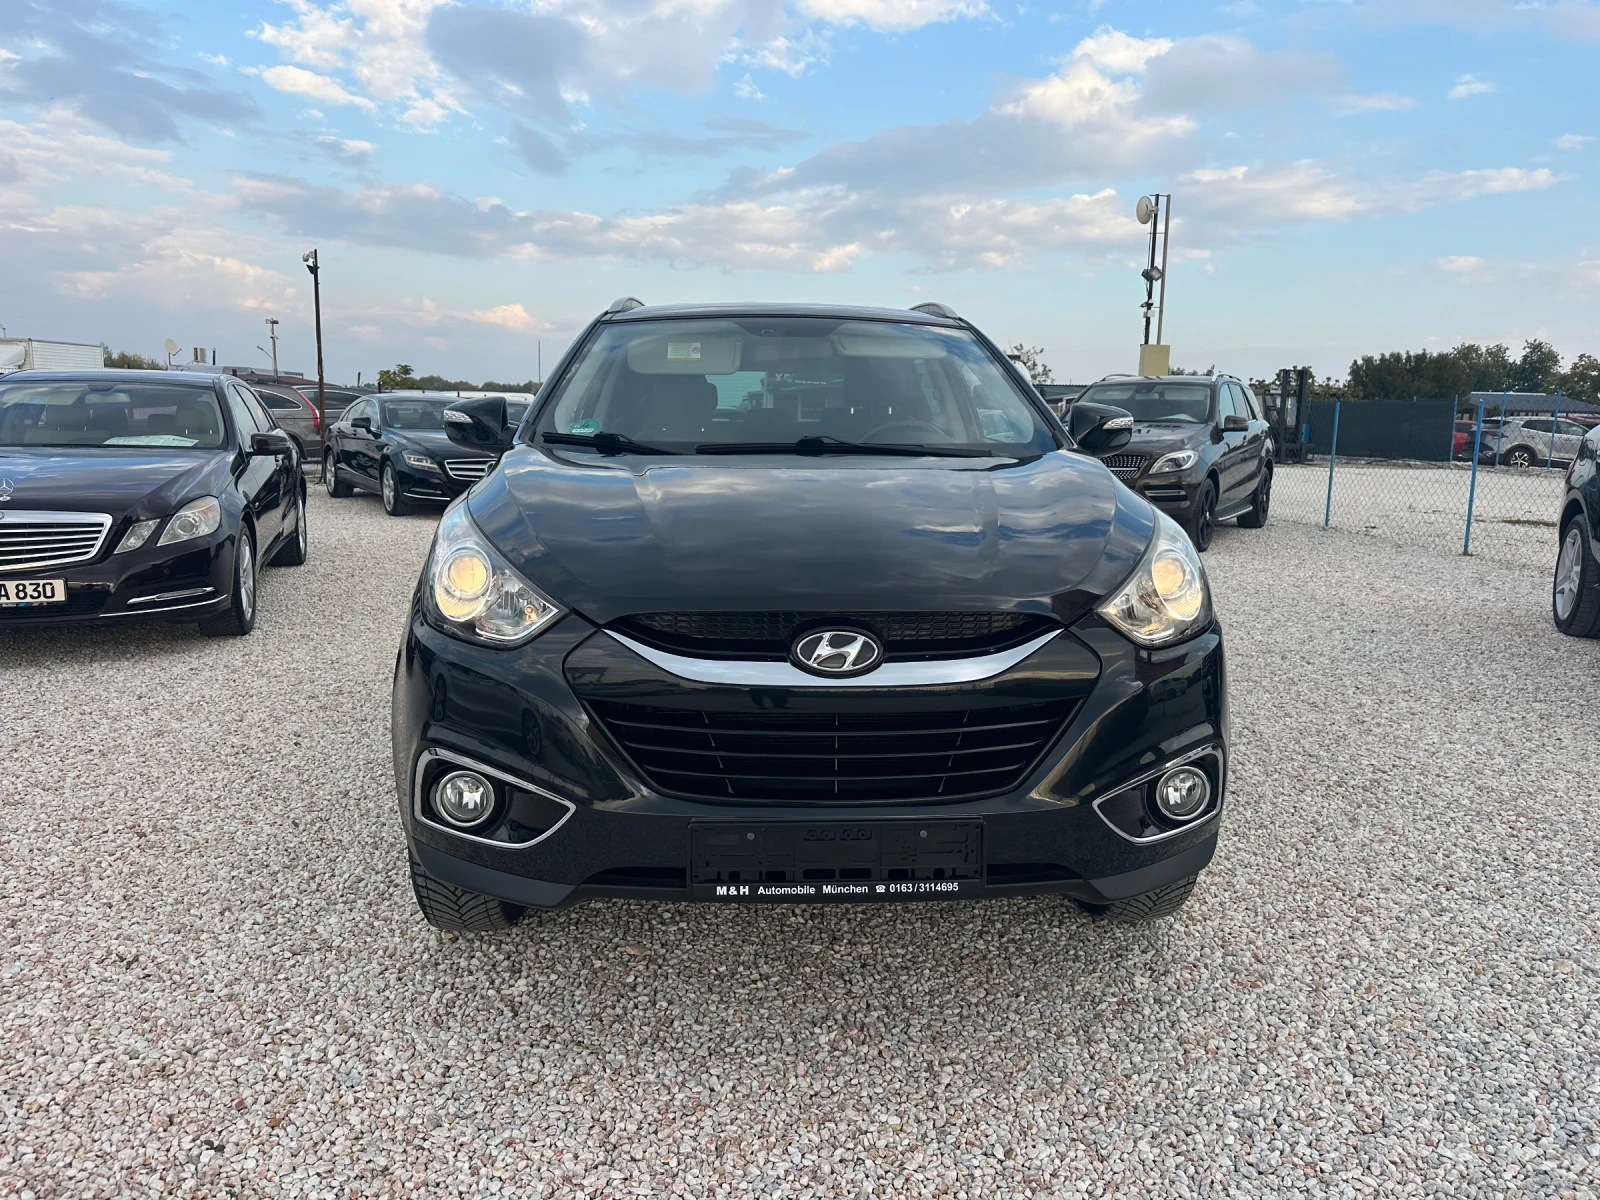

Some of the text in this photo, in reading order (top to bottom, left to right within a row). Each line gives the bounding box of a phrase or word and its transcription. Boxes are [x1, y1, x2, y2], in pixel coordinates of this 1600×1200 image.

[15, 582, 56, 600] 830
[757, 885, 816, 895] Automobile
[822, 884, 869, 894] München
